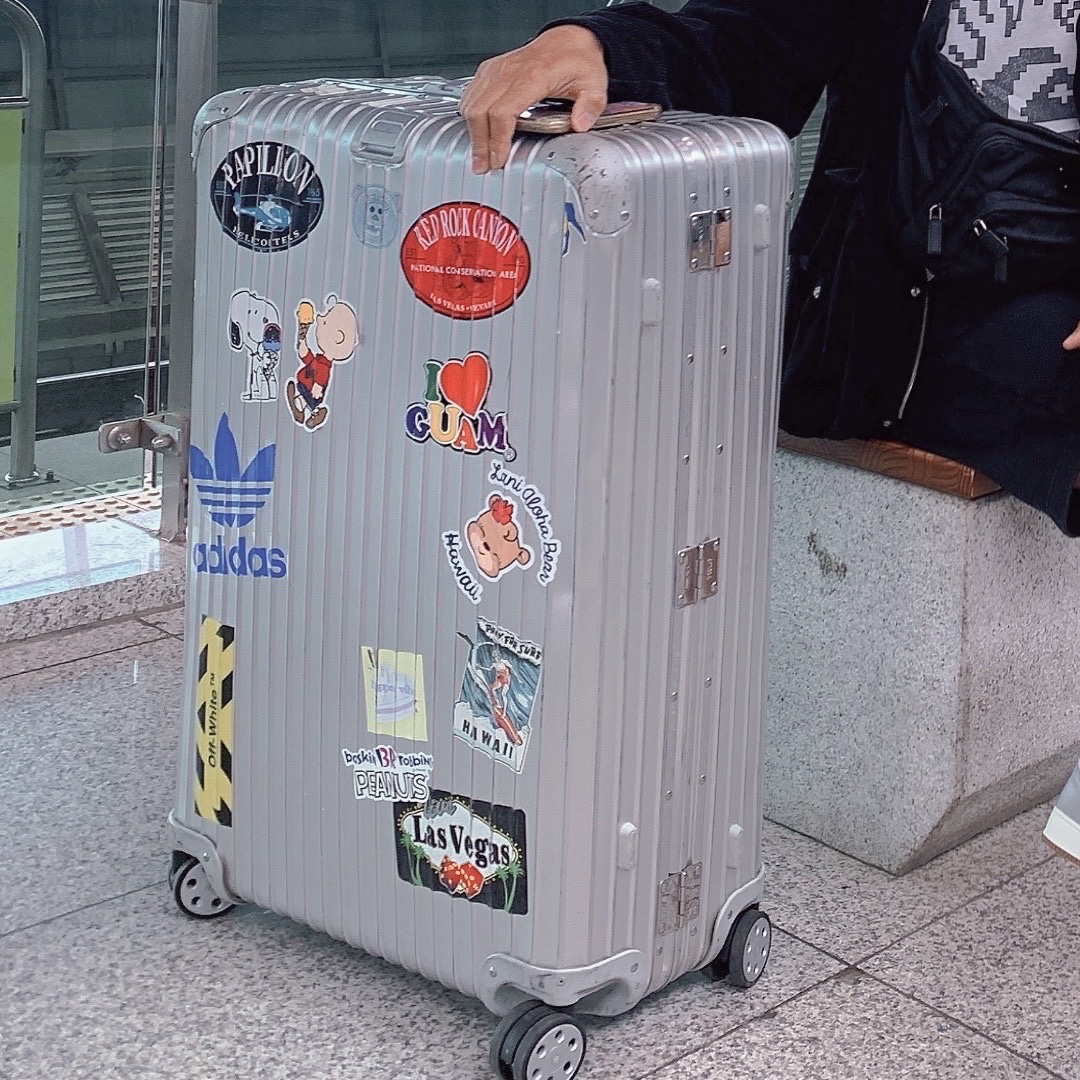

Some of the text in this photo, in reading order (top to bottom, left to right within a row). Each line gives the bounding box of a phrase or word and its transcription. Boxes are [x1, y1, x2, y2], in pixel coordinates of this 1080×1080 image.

[412, 214, 440, 251] RED
[439, 207, 472, 239] ROCK
[424, 361, 442, 403] I
[405, 401, 510, 454] GUAM
[193, 534, 288, 579] adidas
[444, 532, 480, 603] Hawaii
[540, 541, 558, 584] Bear
[208, 689, 218, 768] Off-White
[462, 719, 514, 759] HAWAII
[354, 769, 429, 800] PEANUTS
[412, 815, 511, 869] Las Vegas
